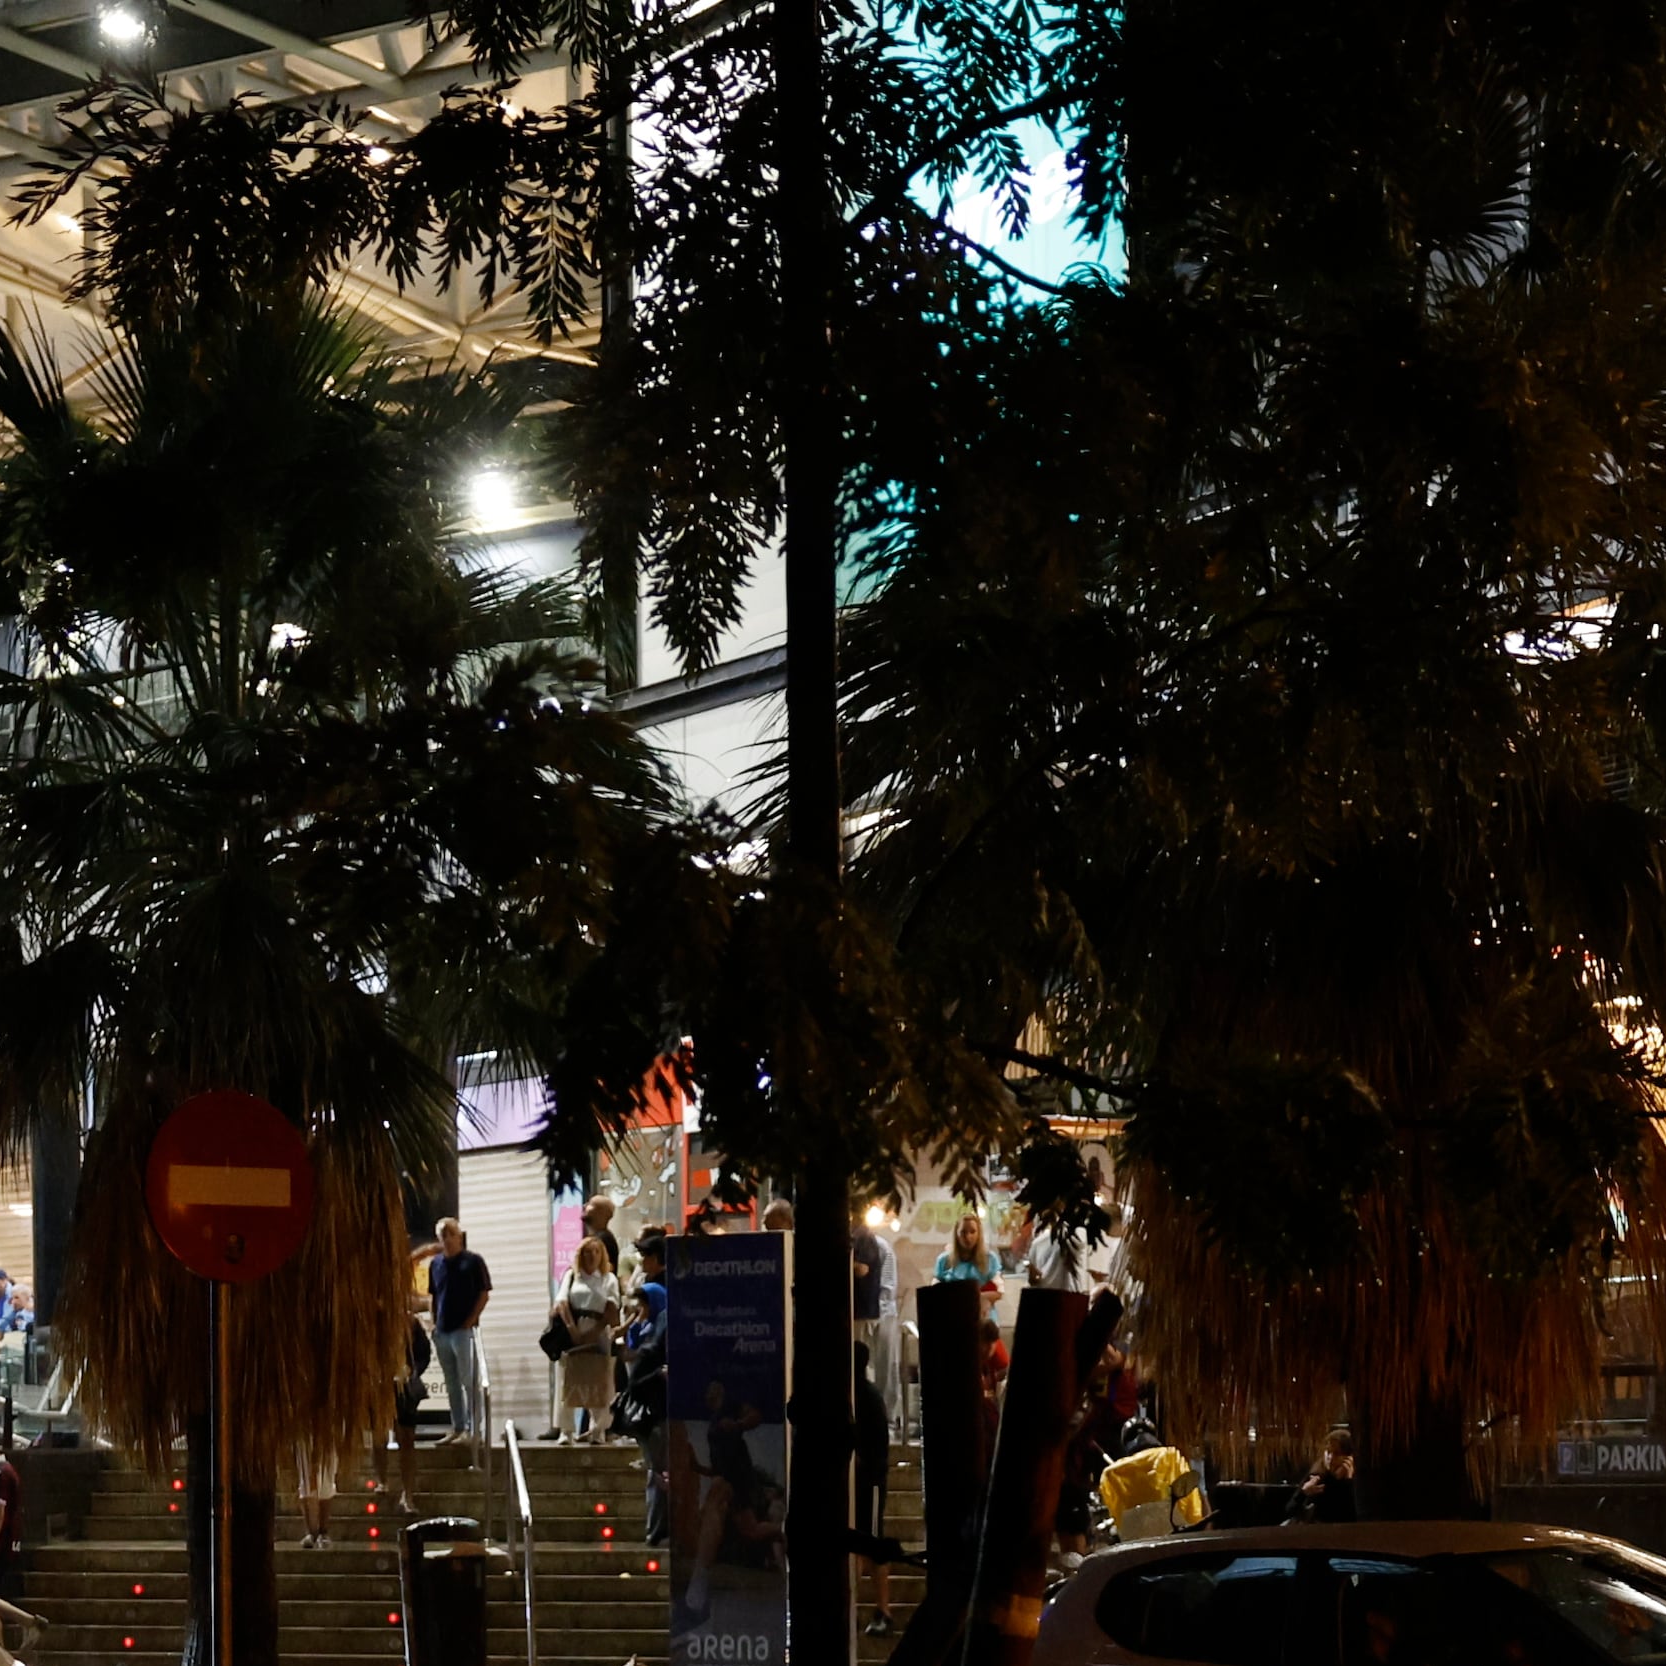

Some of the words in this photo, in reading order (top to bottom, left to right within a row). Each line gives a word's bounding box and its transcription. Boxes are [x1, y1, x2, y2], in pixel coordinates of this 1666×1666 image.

[694, 1260, 776, 1277] DECATHLON
[694, 1321, 770, 1337] Decathlon
[734, 1337, 776, 1355] Arena
